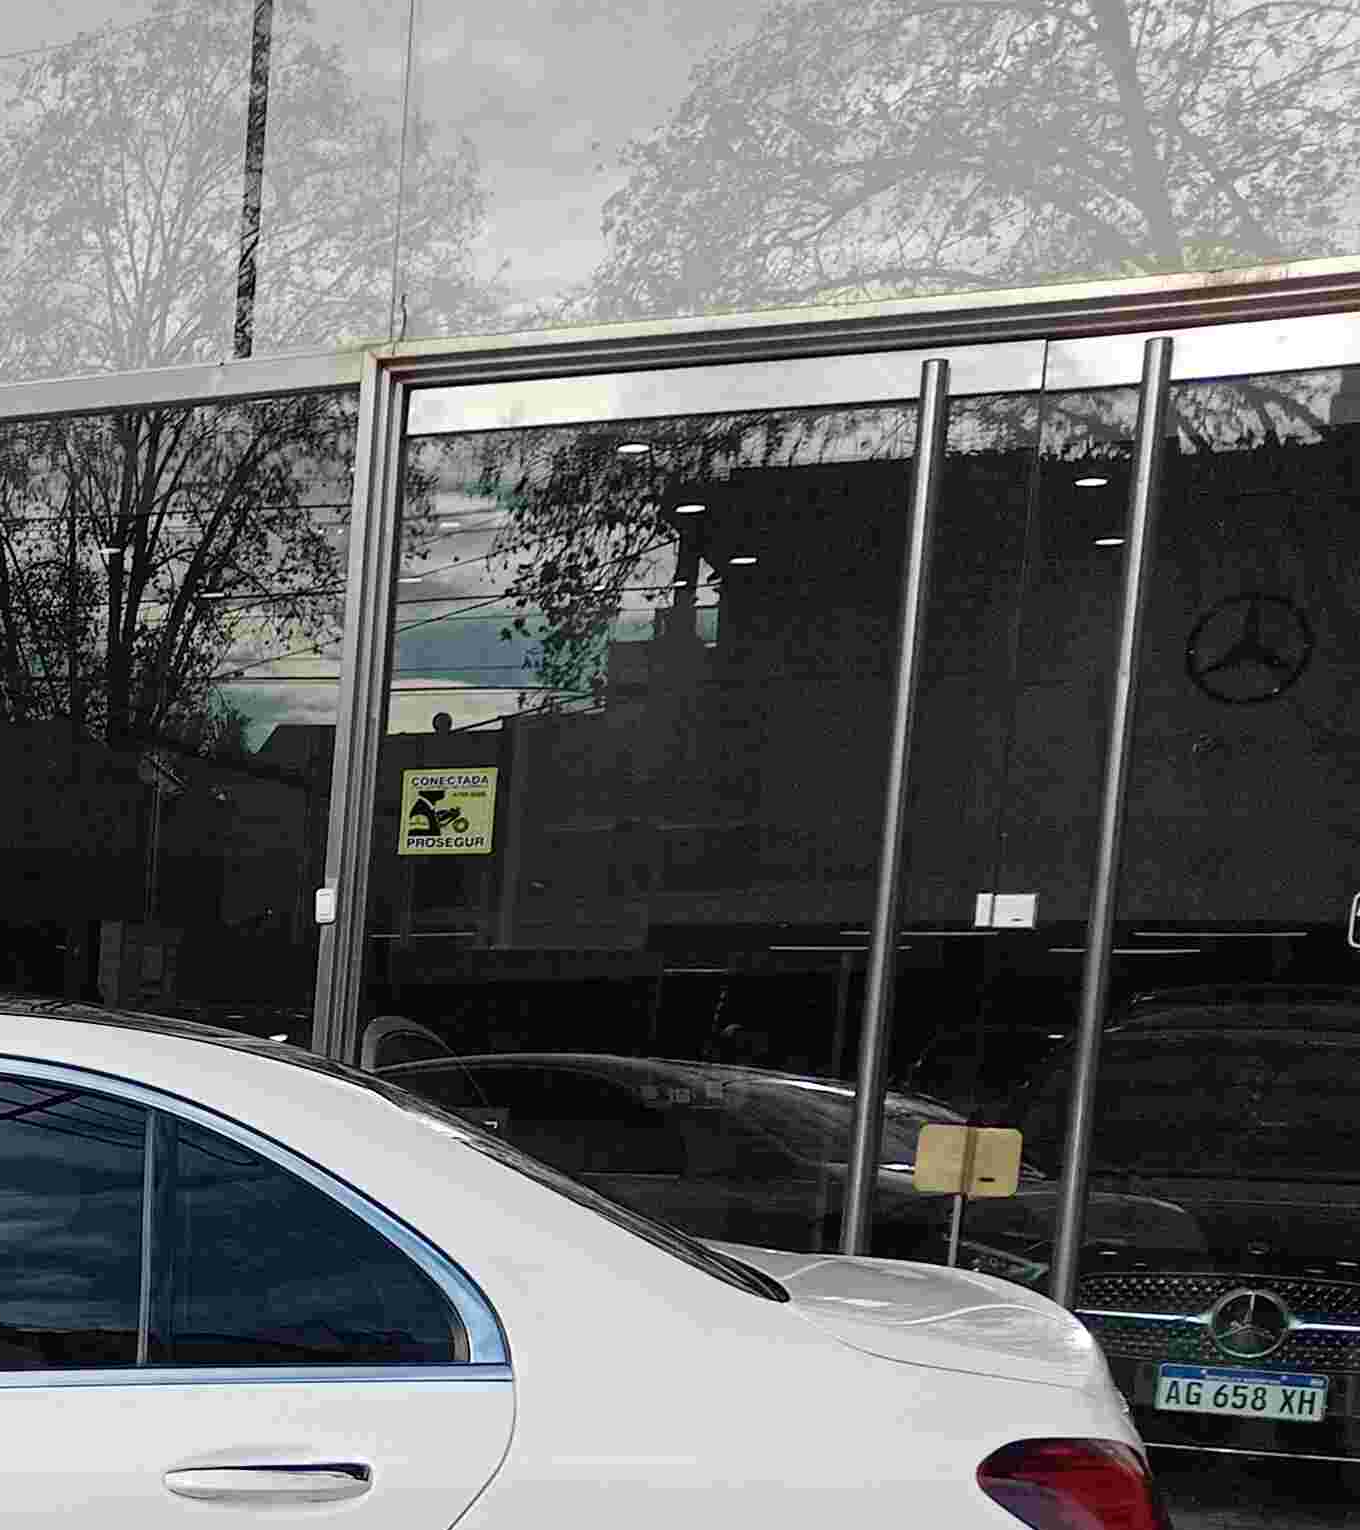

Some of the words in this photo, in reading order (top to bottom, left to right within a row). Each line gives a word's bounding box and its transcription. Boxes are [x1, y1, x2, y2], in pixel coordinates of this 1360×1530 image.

[412, 775, 489, 786] CONECTADA
[407, 836, 485, 848] PROSEGUR
[1165, 1379, 1202, 1405] AG
[1213, 1383, 1267, 1411] 658
[1280, 1388, 1316, 1415] XH
